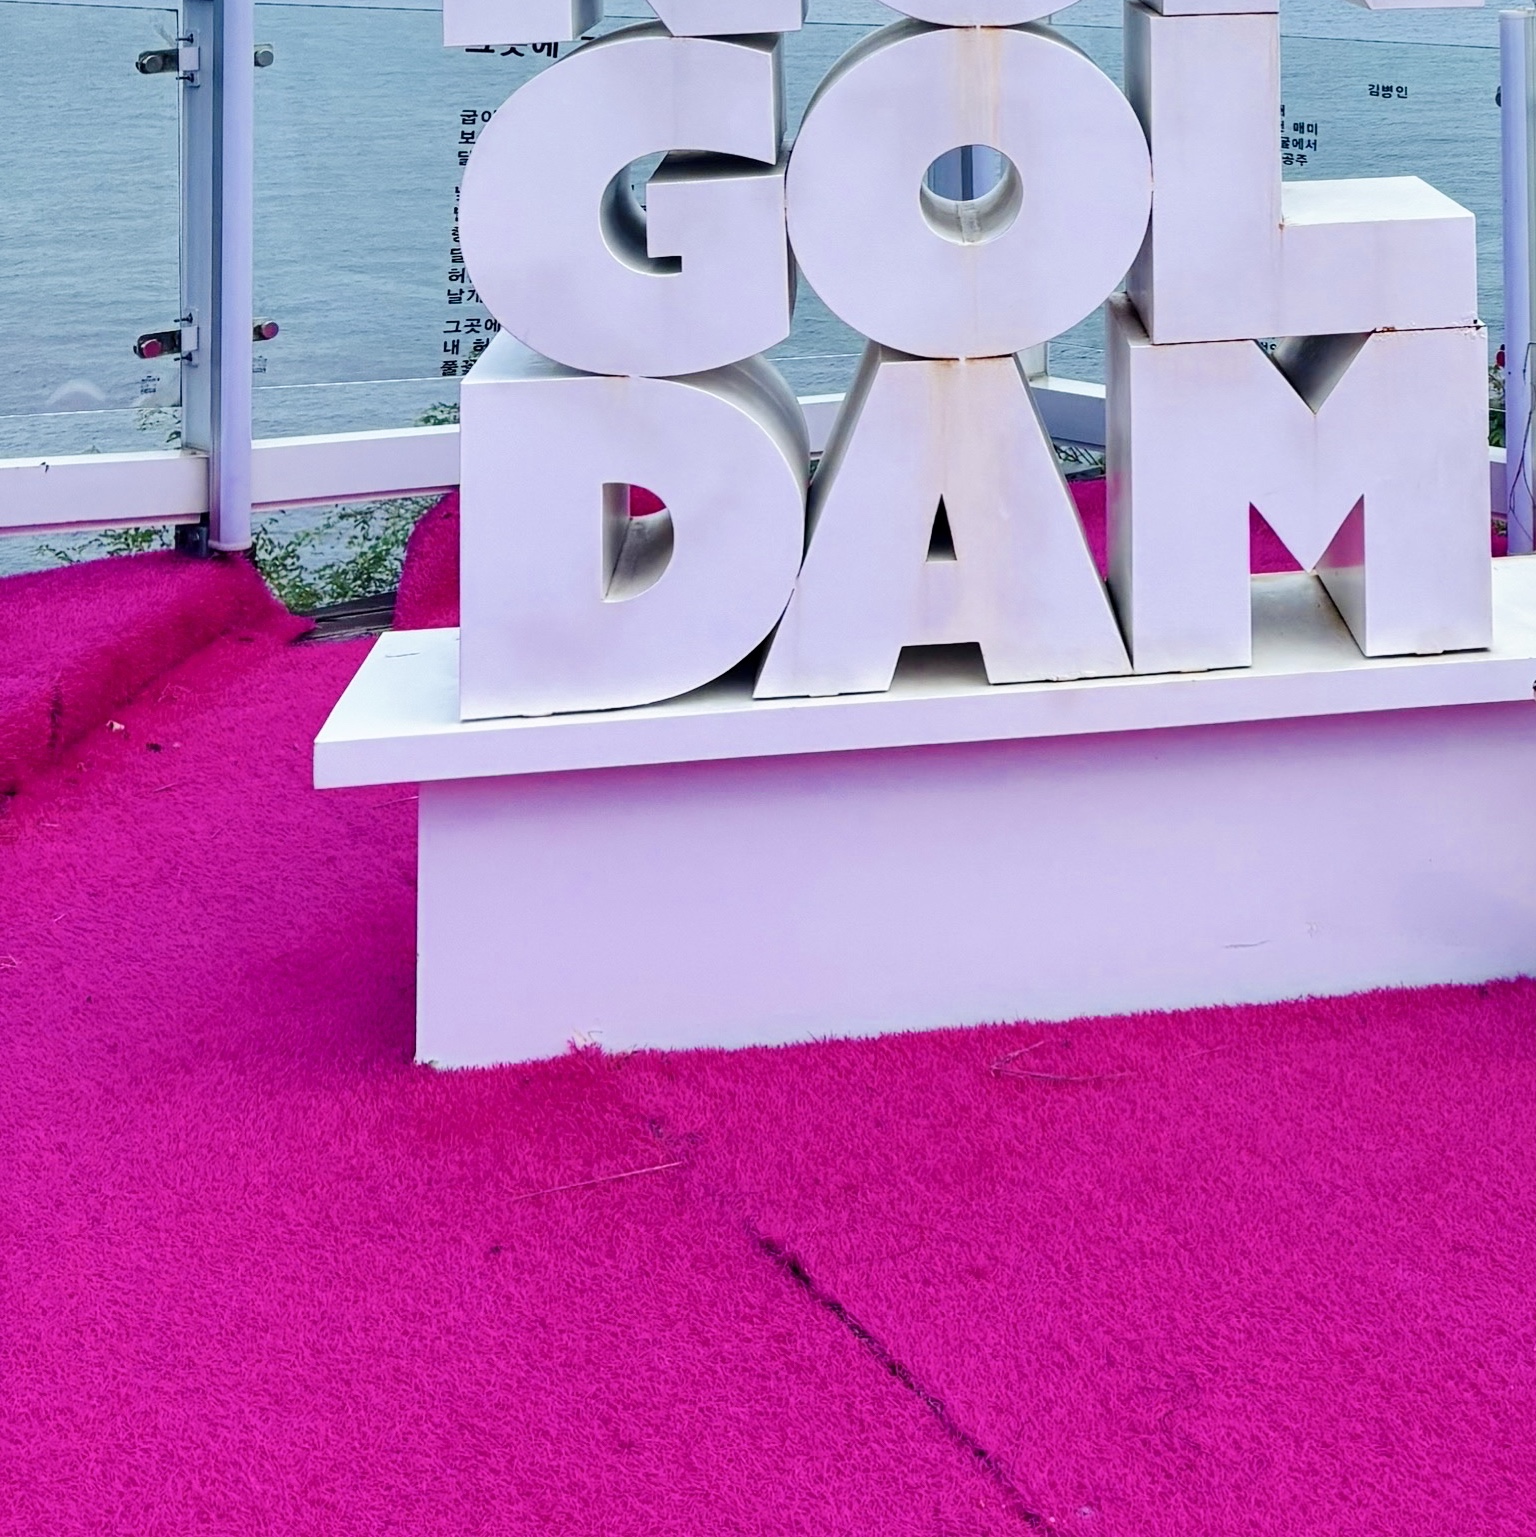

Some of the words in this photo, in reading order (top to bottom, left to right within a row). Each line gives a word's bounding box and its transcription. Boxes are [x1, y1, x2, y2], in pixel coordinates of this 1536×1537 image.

[1368, 83, 1408, 99] 김병인
[459, 11, 1477, 377] GOL
[443, 318, 501, 334] 그곳에
[443, 338, 460, 356] 내
[459, 325, 1493, 721] DAM
